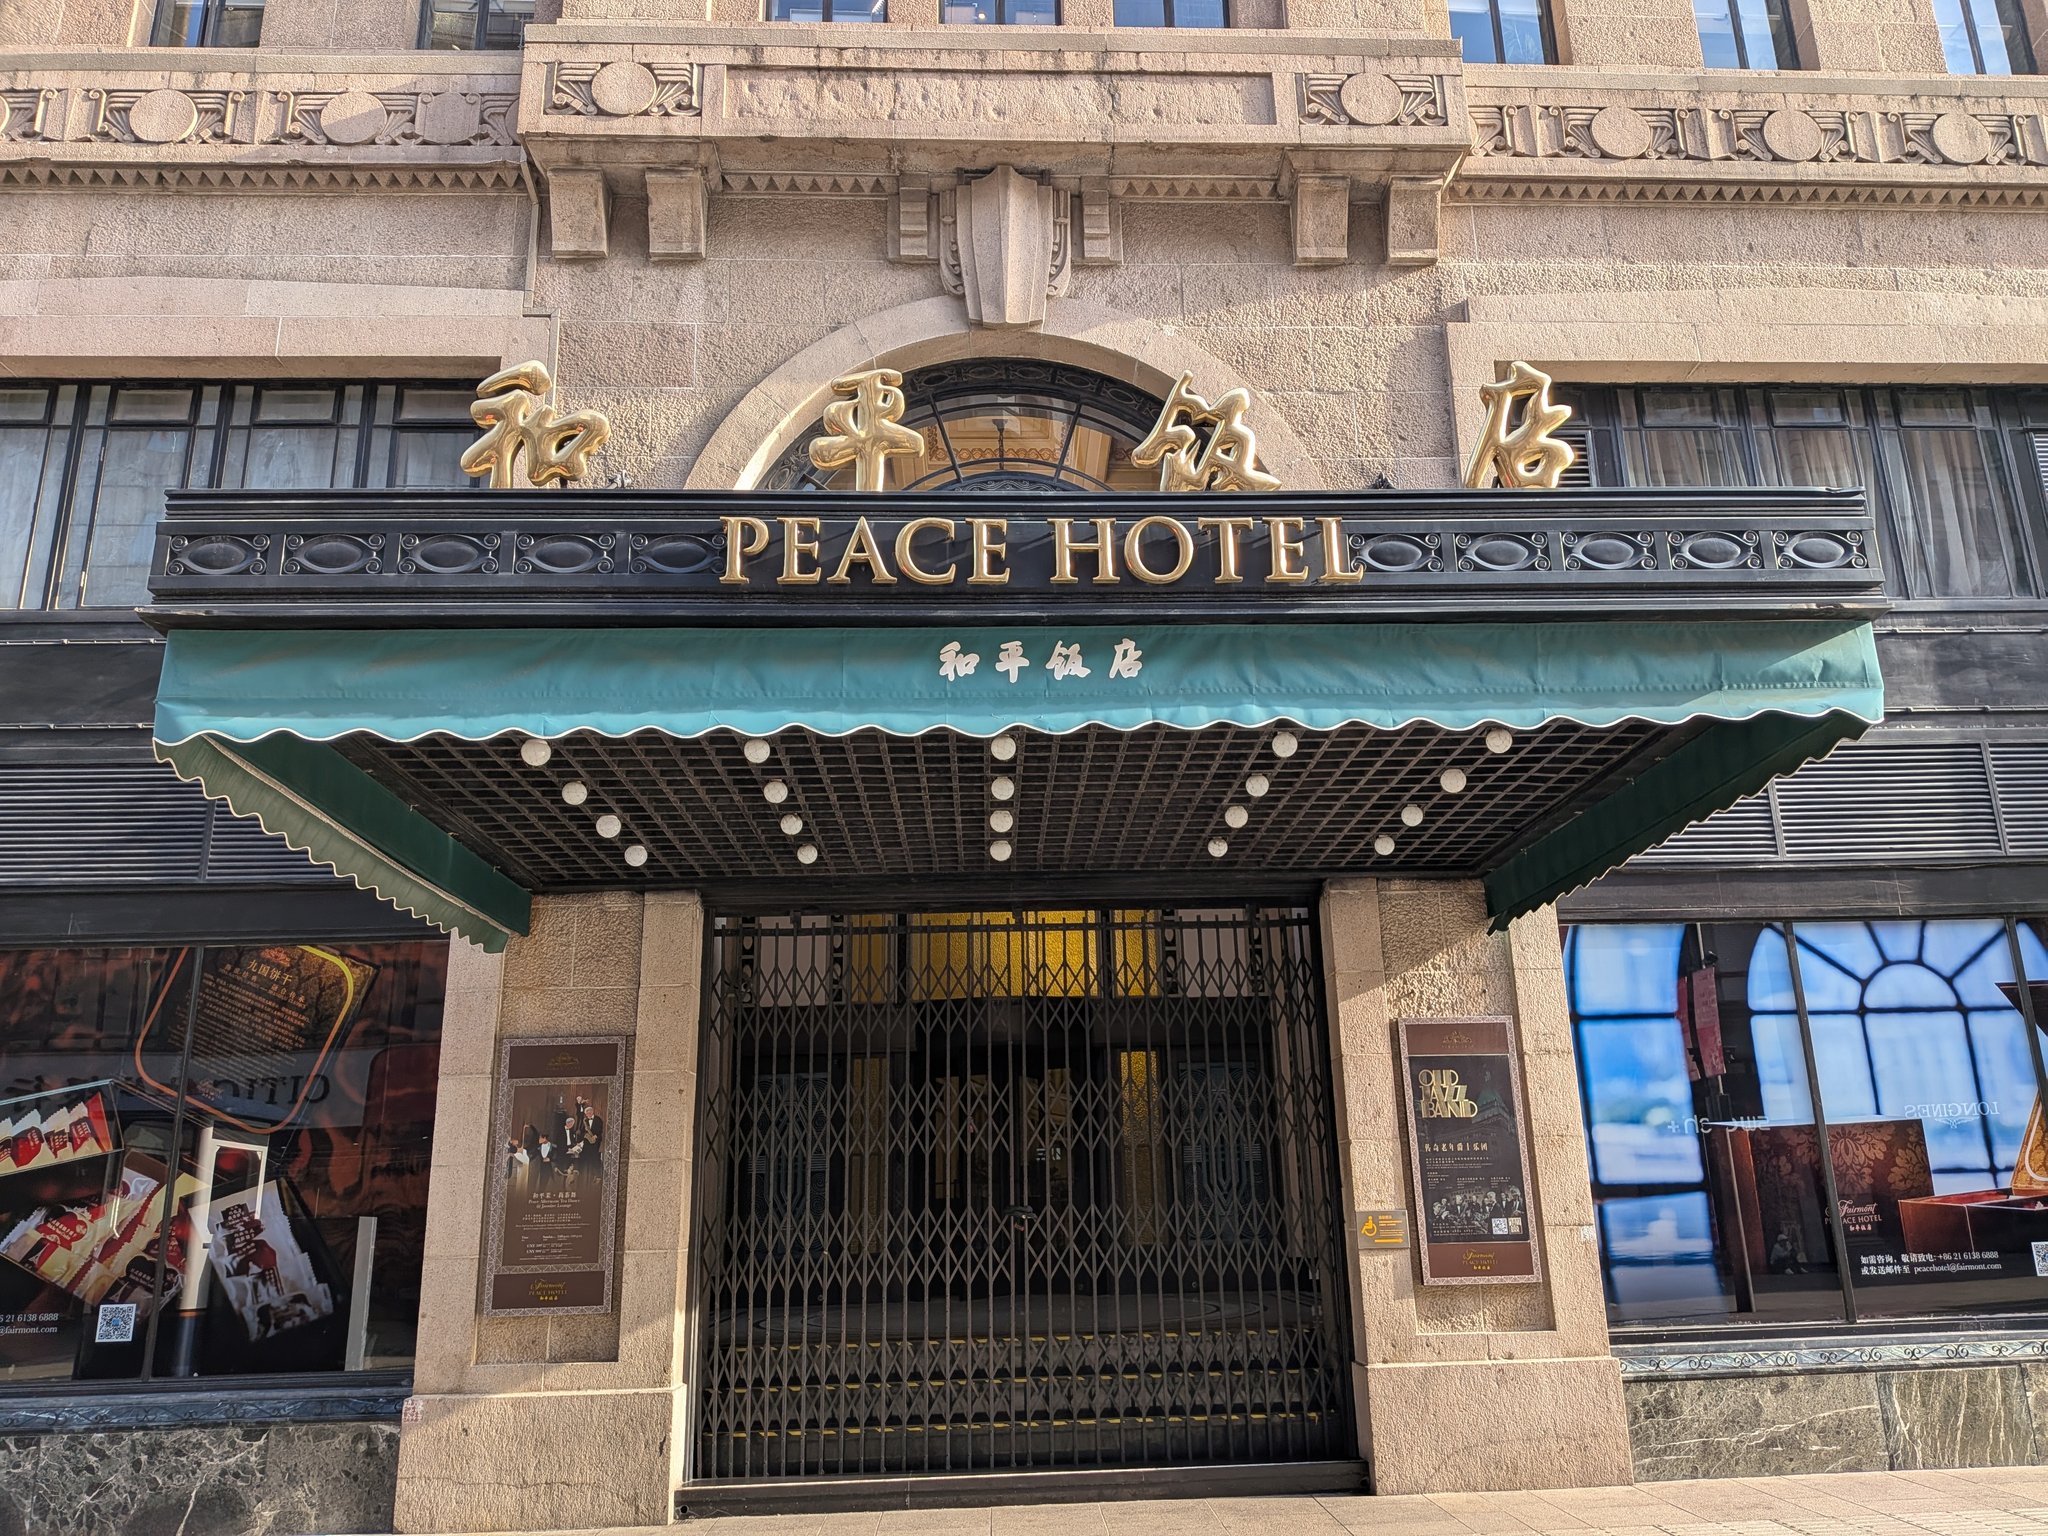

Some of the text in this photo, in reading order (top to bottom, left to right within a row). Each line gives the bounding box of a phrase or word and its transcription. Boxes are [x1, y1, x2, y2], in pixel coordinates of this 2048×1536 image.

[461, 360, 1574, 491] 和平饭店
[719, 516, 1364, 585] PEACE HOTEL
[939, 638, 1143, 683] 和平饭店
[247, 959, 293, 986] 九国饼干
[1418, 1069, 1459, 1086] OLD
[1419, 1085, 1469, 1101] JAZZ
[1420, 1100, 1478, 1118] BAND
[1825, 1199, 1878, 1217] Fairmont
[1857, 1214, 1883, 1223] HOTEL
[1953, 1252, 1961, 1260] 21
[1963, 1251, 1981, 1259] 6138
[1981, 1251, 1999, 1259] 6888
[5, 1315, 15, 1323] 21
[17, 1313, 37, 1322] 6138
[38, 1312, 59, 1321] 6888
